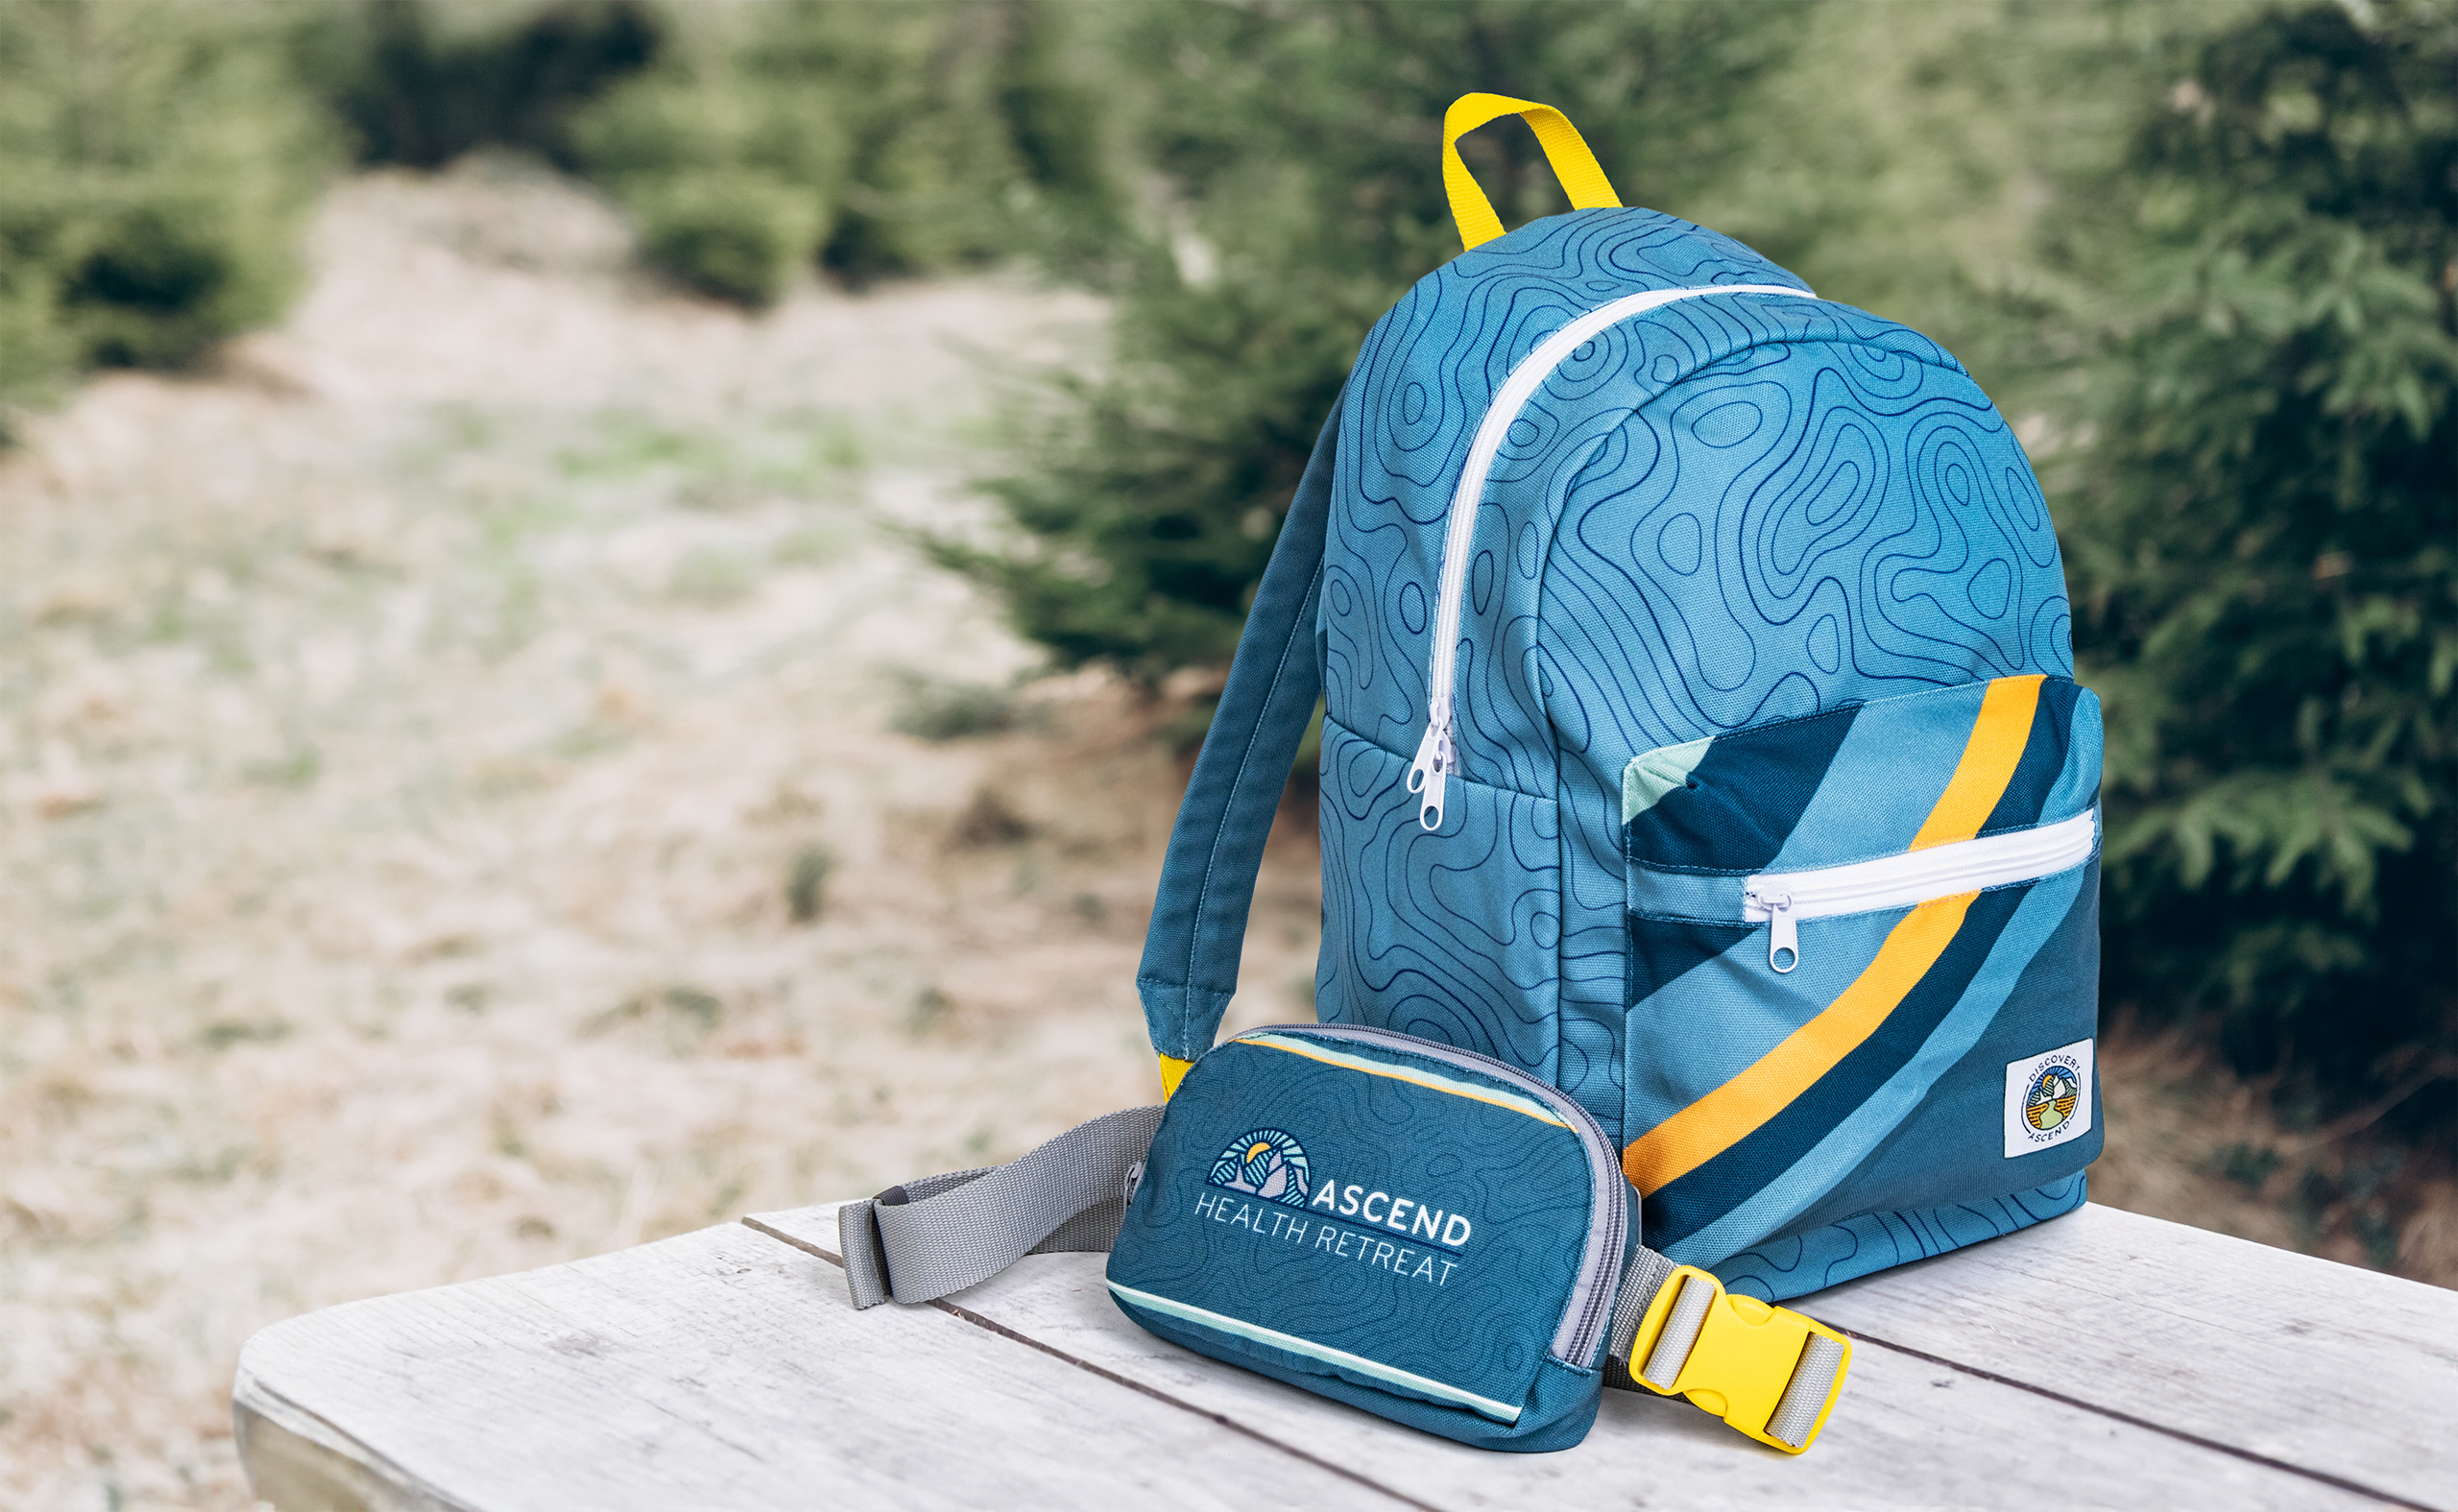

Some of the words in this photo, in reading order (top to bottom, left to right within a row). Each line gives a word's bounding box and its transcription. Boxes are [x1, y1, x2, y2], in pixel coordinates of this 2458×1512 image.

[2029, 1054, 2081, 1082] DISCOVERY
[2028, 1120, 2070, 1142] ASCEND
[1312, 1179, 1471, 1246] ASCEND
[1195, 1192, 1309, 1244] HEALTH
[1314, 1225, 1458, 1286] RETREAT
